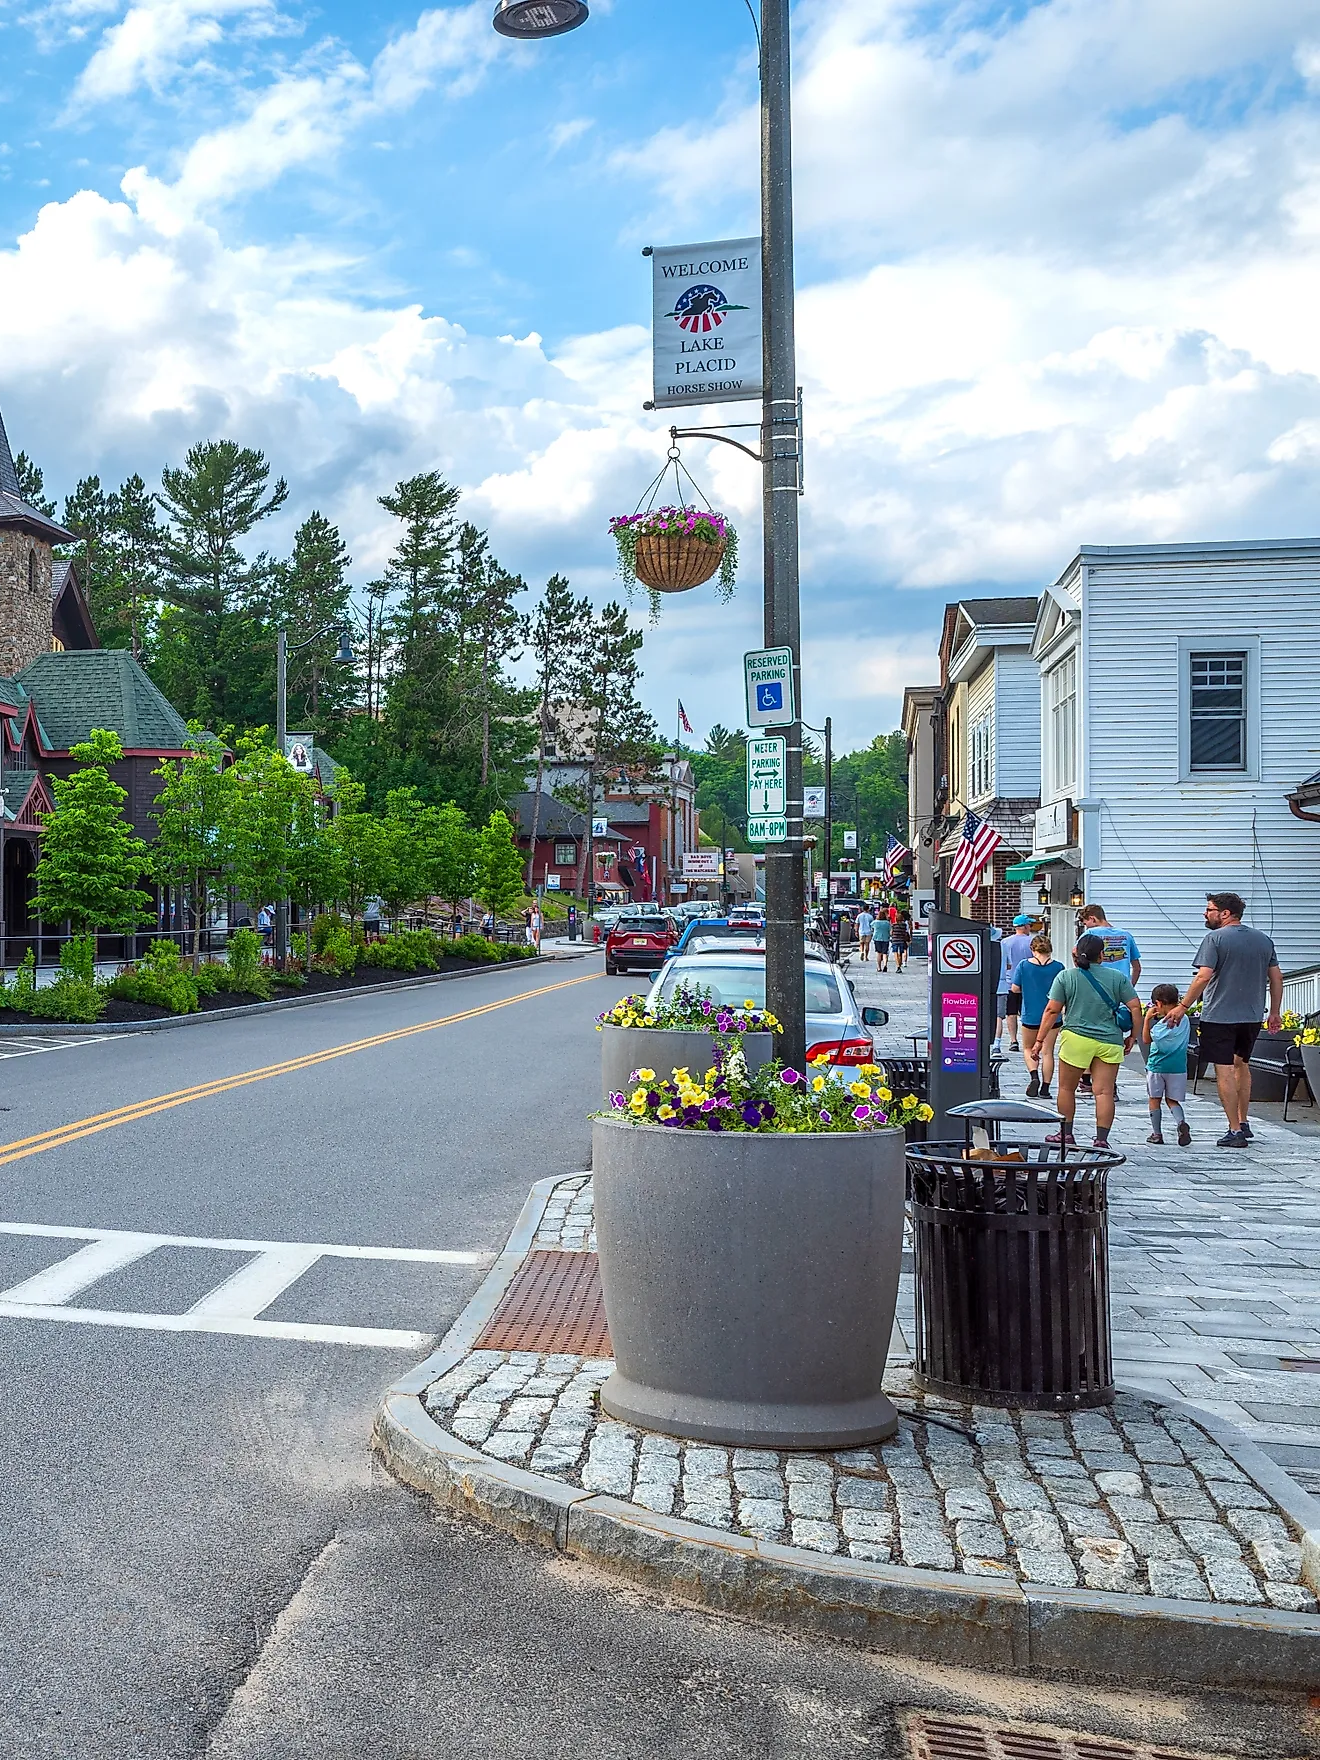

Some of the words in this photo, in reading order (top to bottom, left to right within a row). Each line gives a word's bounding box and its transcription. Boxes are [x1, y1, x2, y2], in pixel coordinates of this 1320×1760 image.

[661, 257, 749, 278] WELCOME
[680, 337, 724, 353] LAKE
[675, 358, 736, 374] PLACID
[667, 383, 706, 395] HORSE
[708, 380, 743, 392] SHOW
[747, 654, 788, 669] RESERVED
[750, 668, 786, 682] PARKING
[754, 742, 778, 753] METER
[751, 757, 781, 769] PARKING
[749, 780, 762, 790] PAY
[764, 778, 783, 789] HERE
[749, 821, 785, 837] 8AM-8PM
